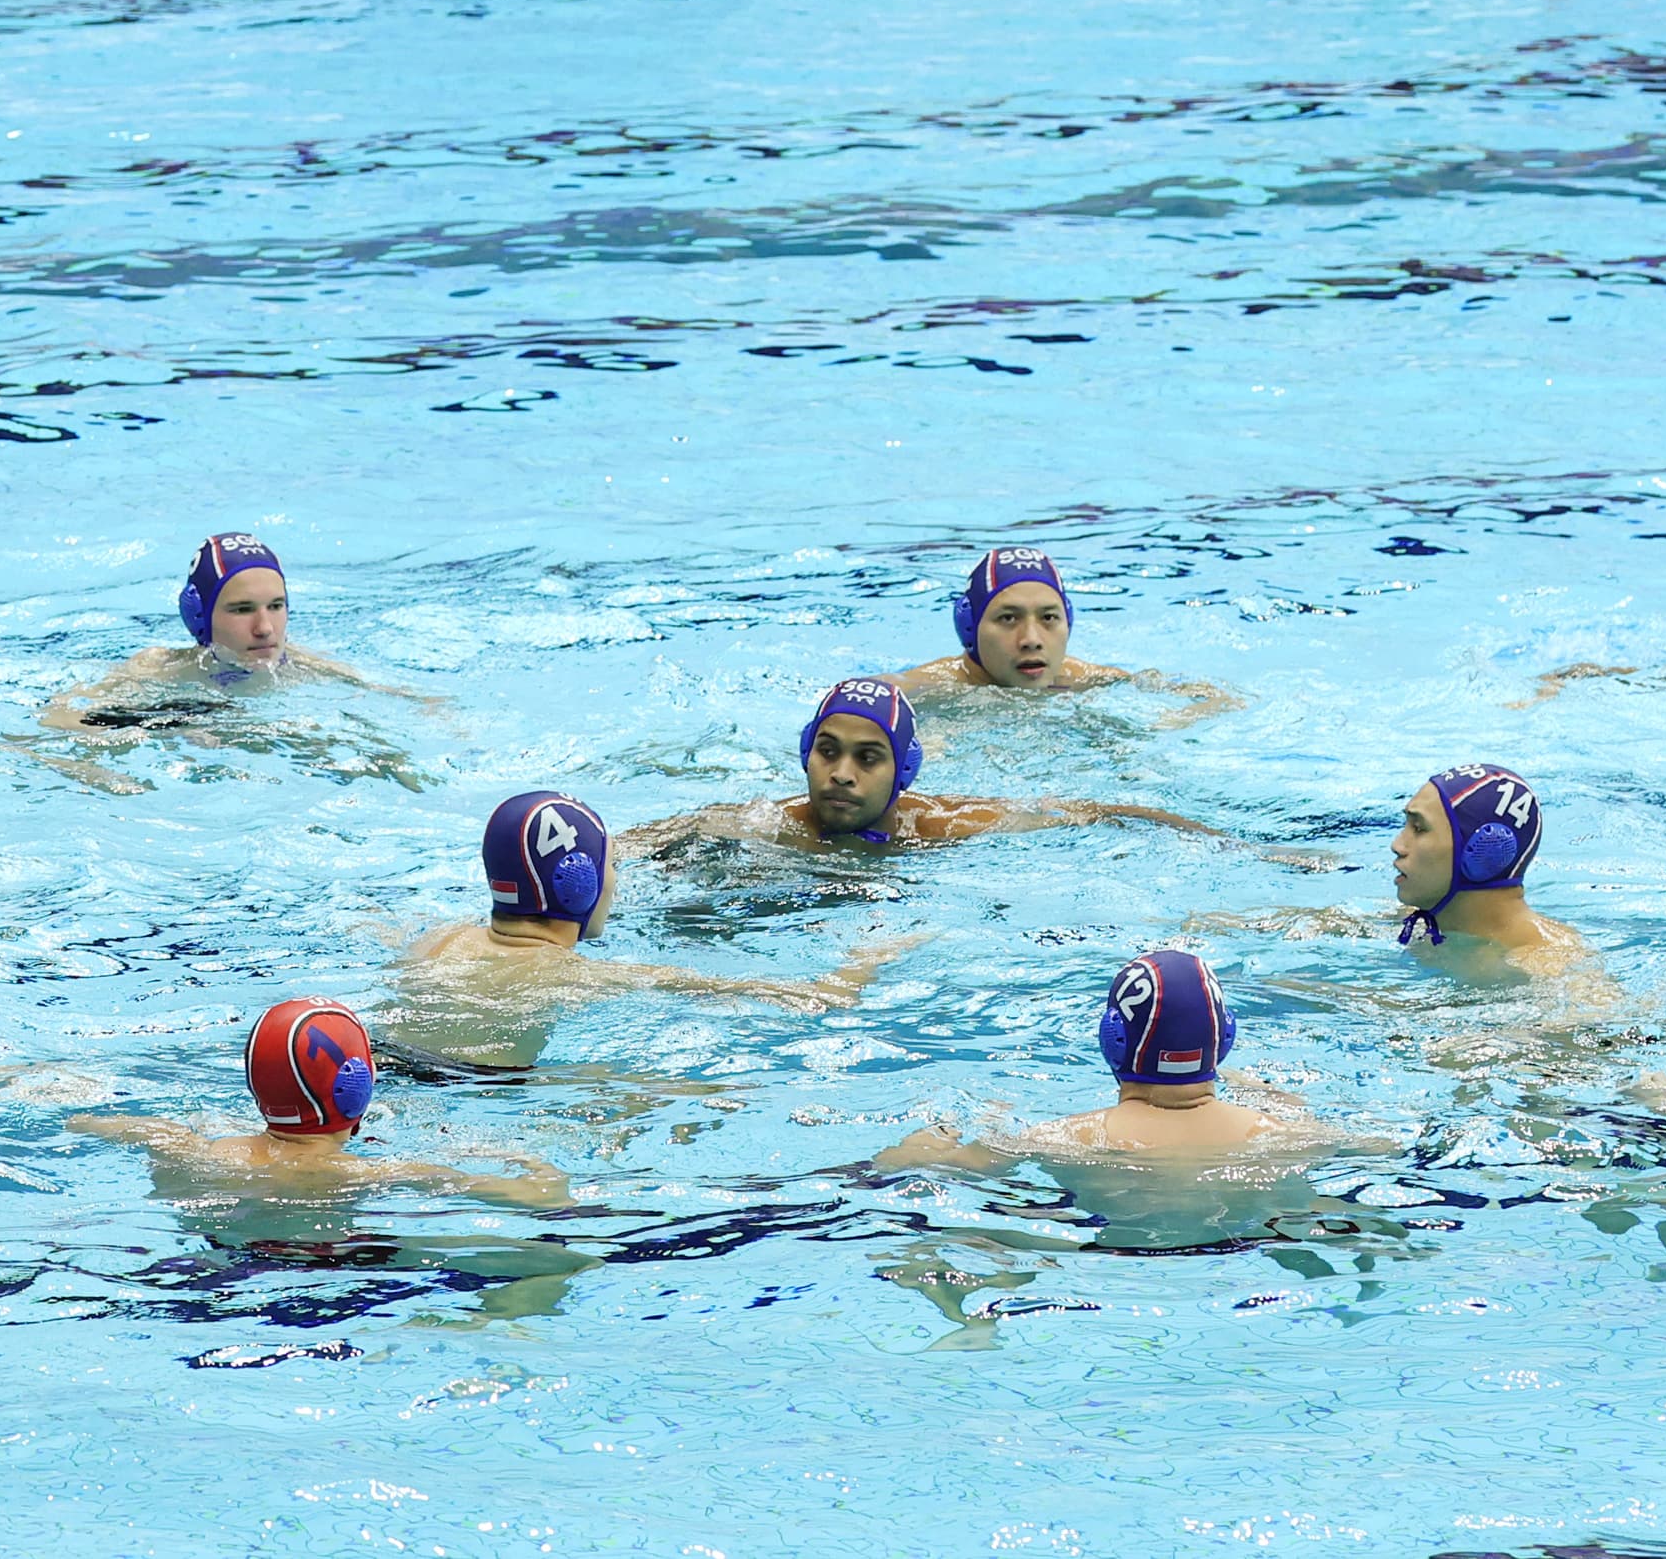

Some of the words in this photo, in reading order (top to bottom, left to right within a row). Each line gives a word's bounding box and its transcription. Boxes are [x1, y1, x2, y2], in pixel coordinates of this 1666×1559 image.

[839, 680, 891, 698] SGP
[845, 693, 876, 706] TYR
[1494, 782, 1533, 829] 14
[536, 806, 579, 858] 4
[1115, 966, 1153, 1023] 12
